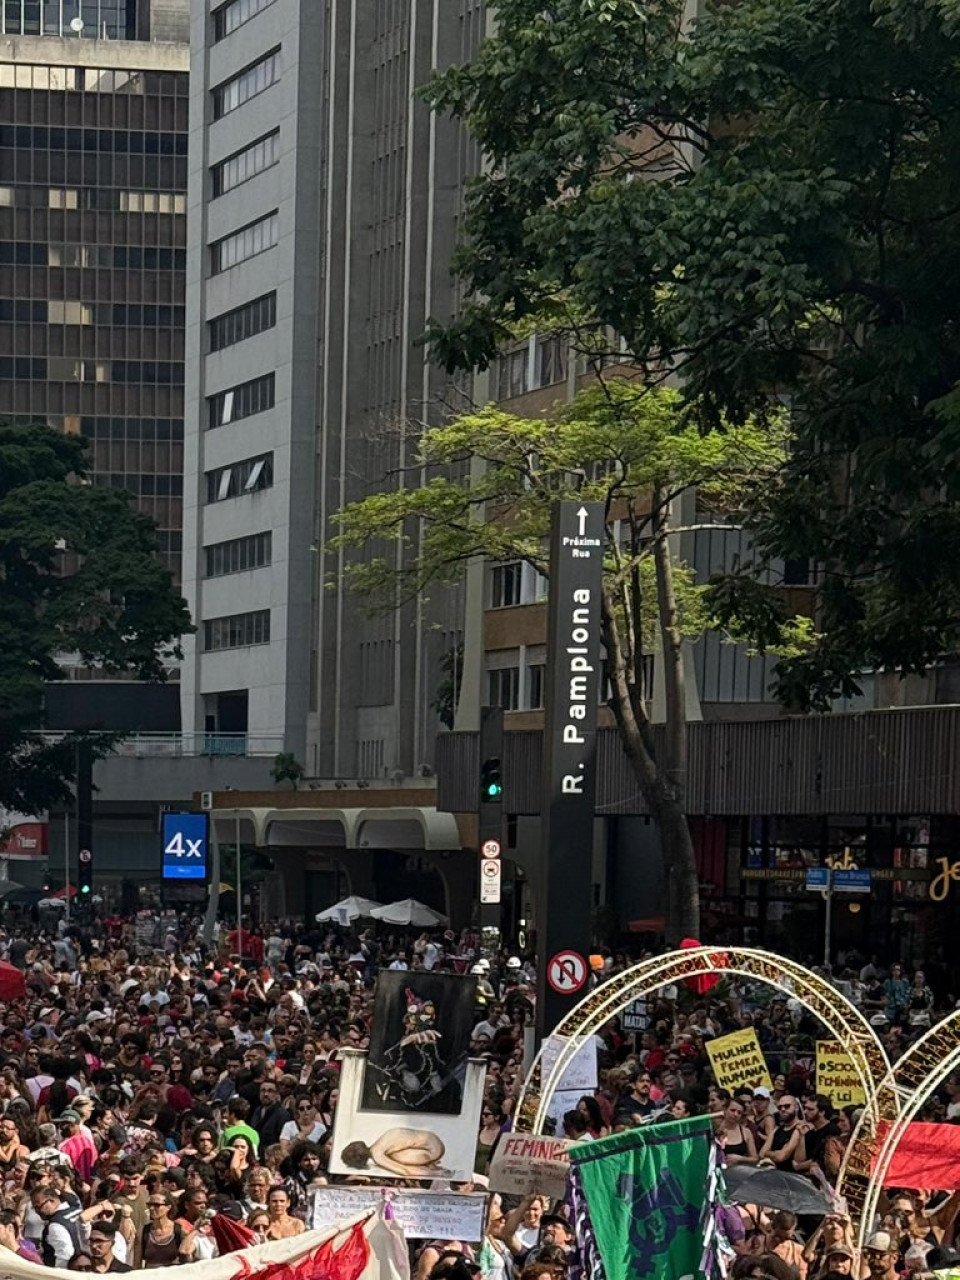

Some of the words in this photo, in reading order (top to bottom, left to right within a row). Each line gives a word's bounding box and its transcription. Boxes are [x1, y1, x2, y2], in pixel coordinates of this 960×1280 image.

[562, 536, 601, 546] Próxima
[571, 549, 591, 558] Rua
[563, 588, 594, 744] Pamplona
[562, 763, 585, 793] R.
[164, 832, 202, 857] 4x
[485, 844, 497, 853] 50
